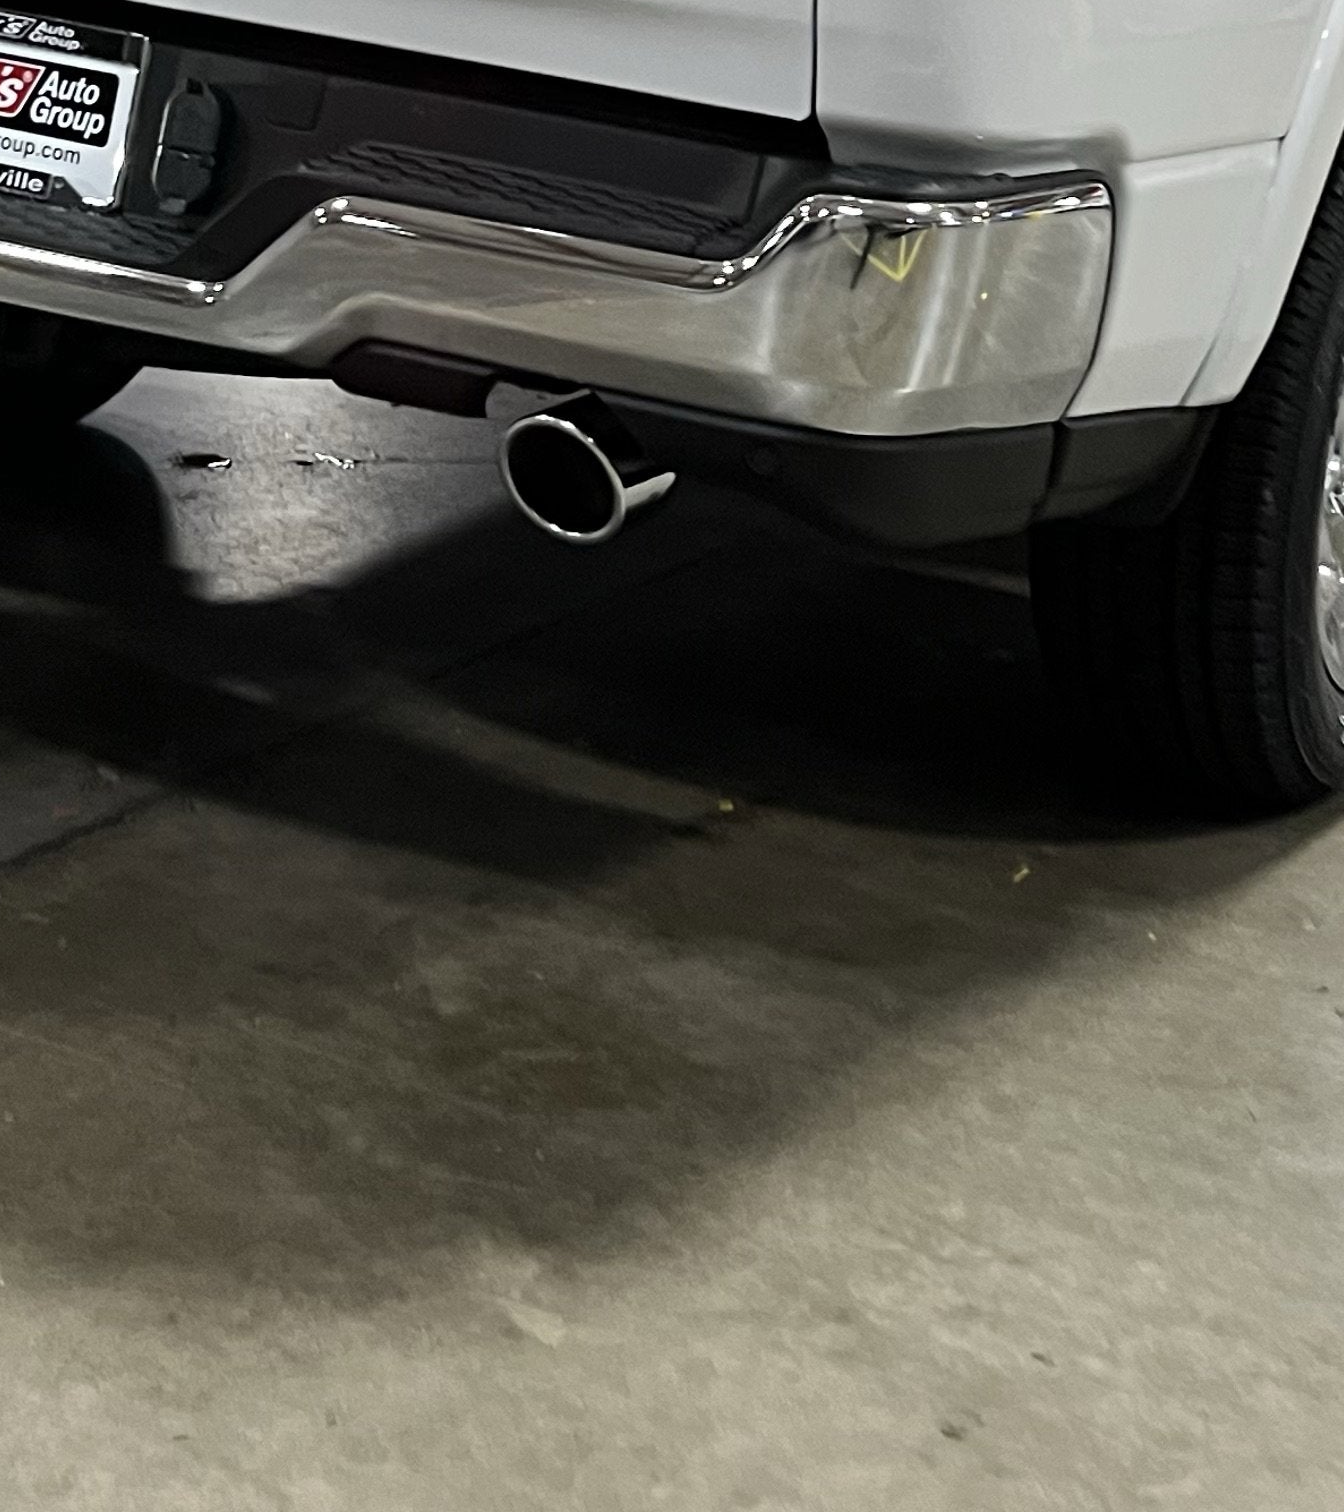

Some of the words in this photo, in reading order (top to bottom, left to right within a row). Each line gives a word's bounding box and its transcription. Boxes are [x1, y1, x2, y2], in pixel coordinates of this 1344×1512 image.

[28, 31, 81, 51] Group
[35, 21, 75, 38] Auto
[38, 70, 101, 106] Auto
[29, 97, 106, 139] Group
